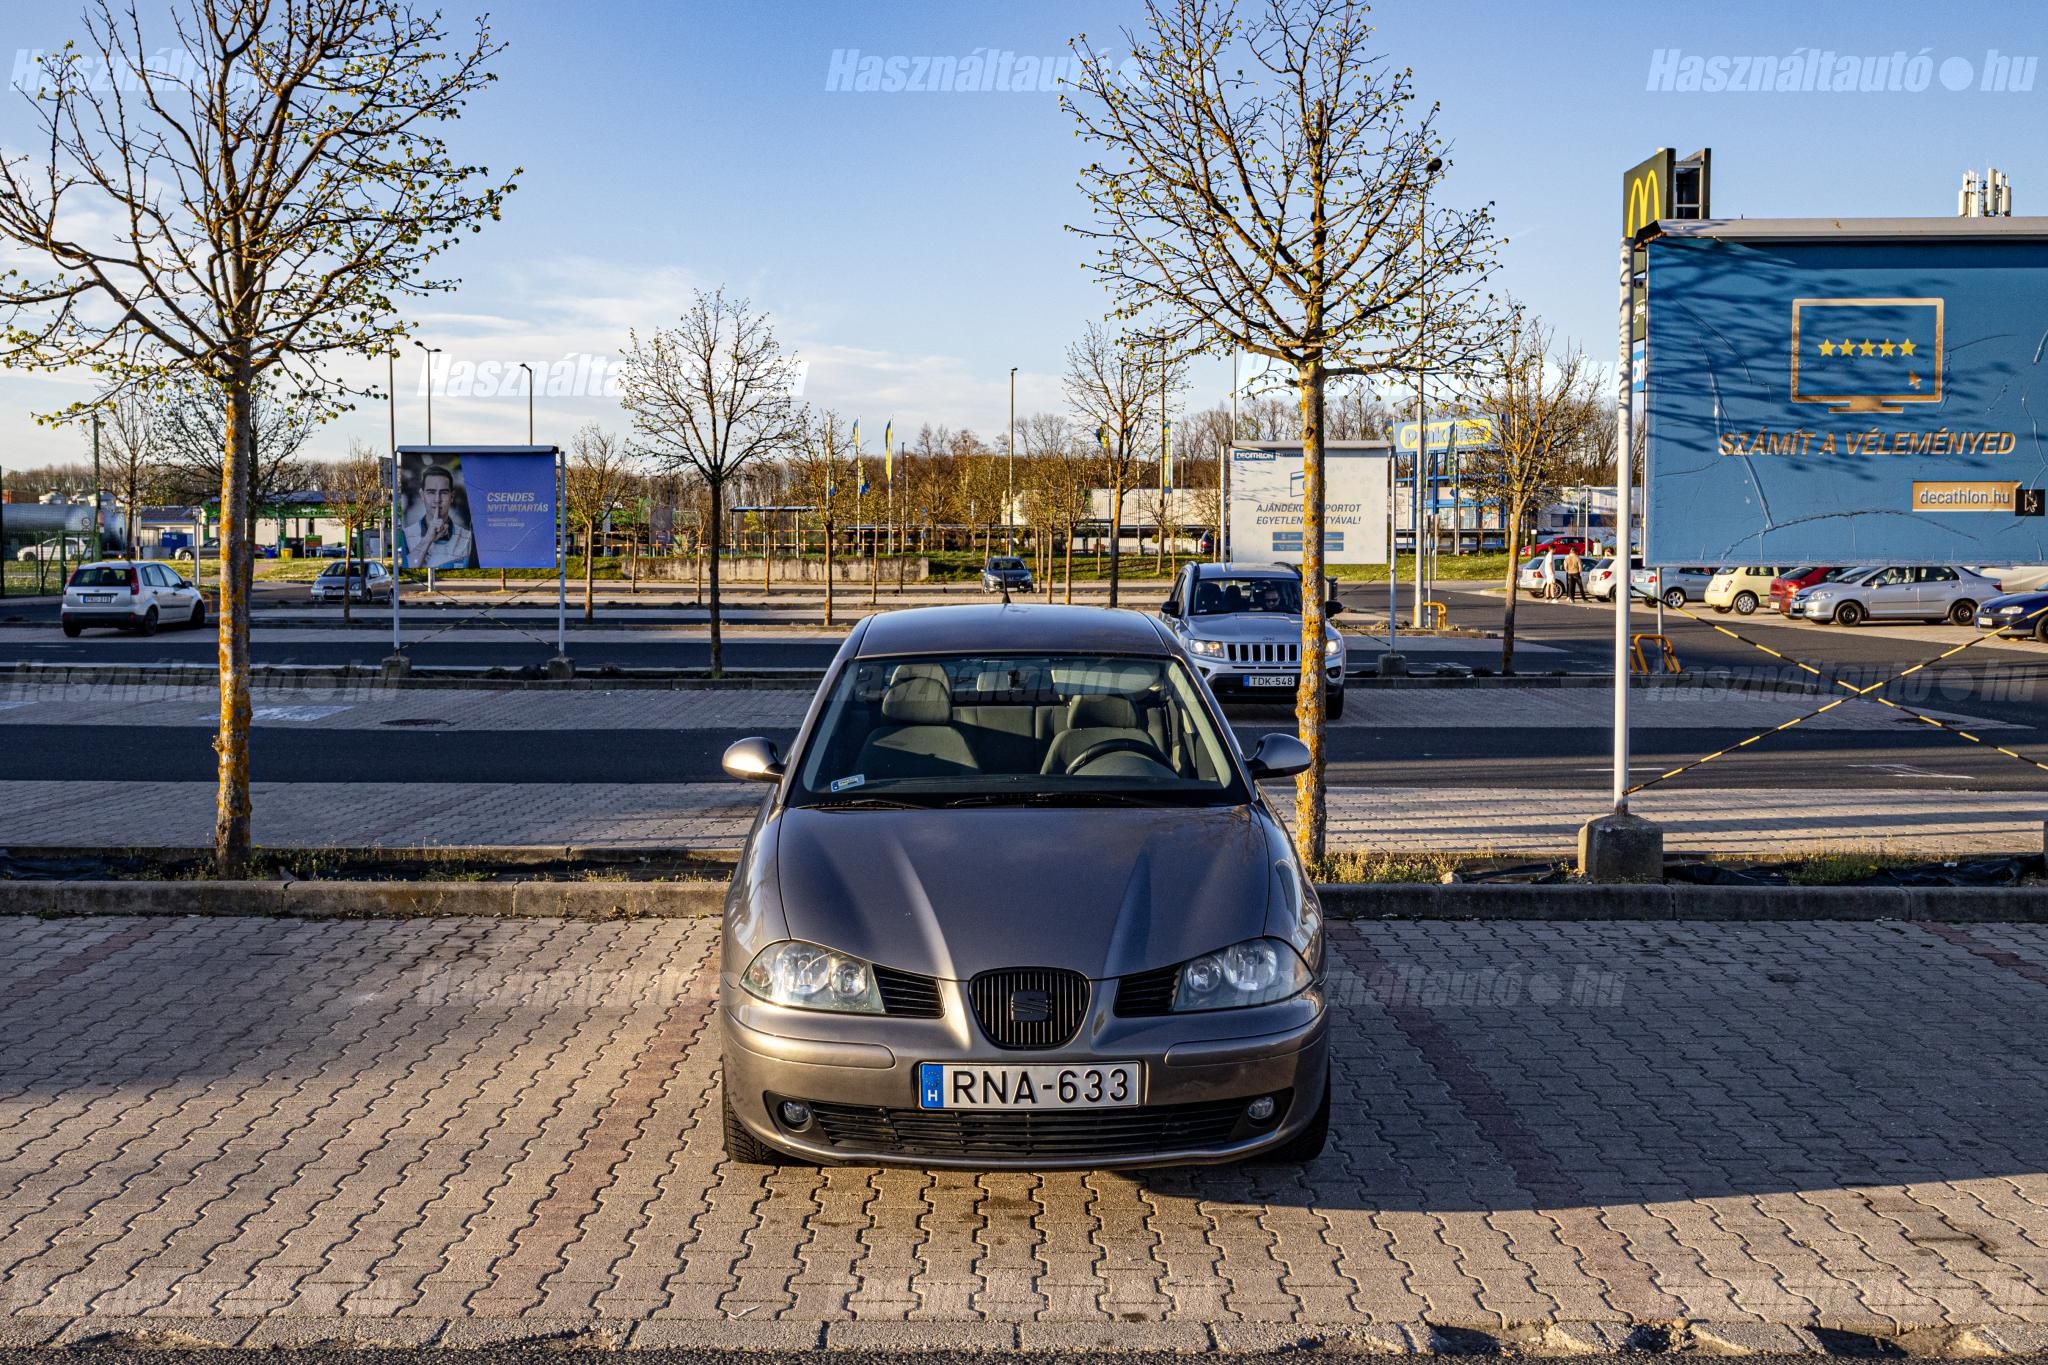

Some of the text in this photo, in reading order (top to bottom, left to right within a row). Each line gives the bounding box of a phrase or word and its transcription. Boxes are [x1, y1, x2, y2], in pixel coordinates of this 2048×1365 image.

[1718, 426, 2016, 456] SZÁMÍT A VÉLEMÉNYED
[1236, 452, 1275, 460] DECATHLON
[487, 492, 535, 502] CSENDES
[1919, 488, 2011, 505] decathlon.hu
[487, 502, 549, 513] NYITVATARTÁS
[1256, 503, 1362, 513] AJÁNDÉKO PORTOT
[1256, 514, 1361, 525] EGYETLEN TYÁVAL!
[1251, 677, 1294, 686] TDK-548
[927, 1068, 1129, 1104] H RNA-633
